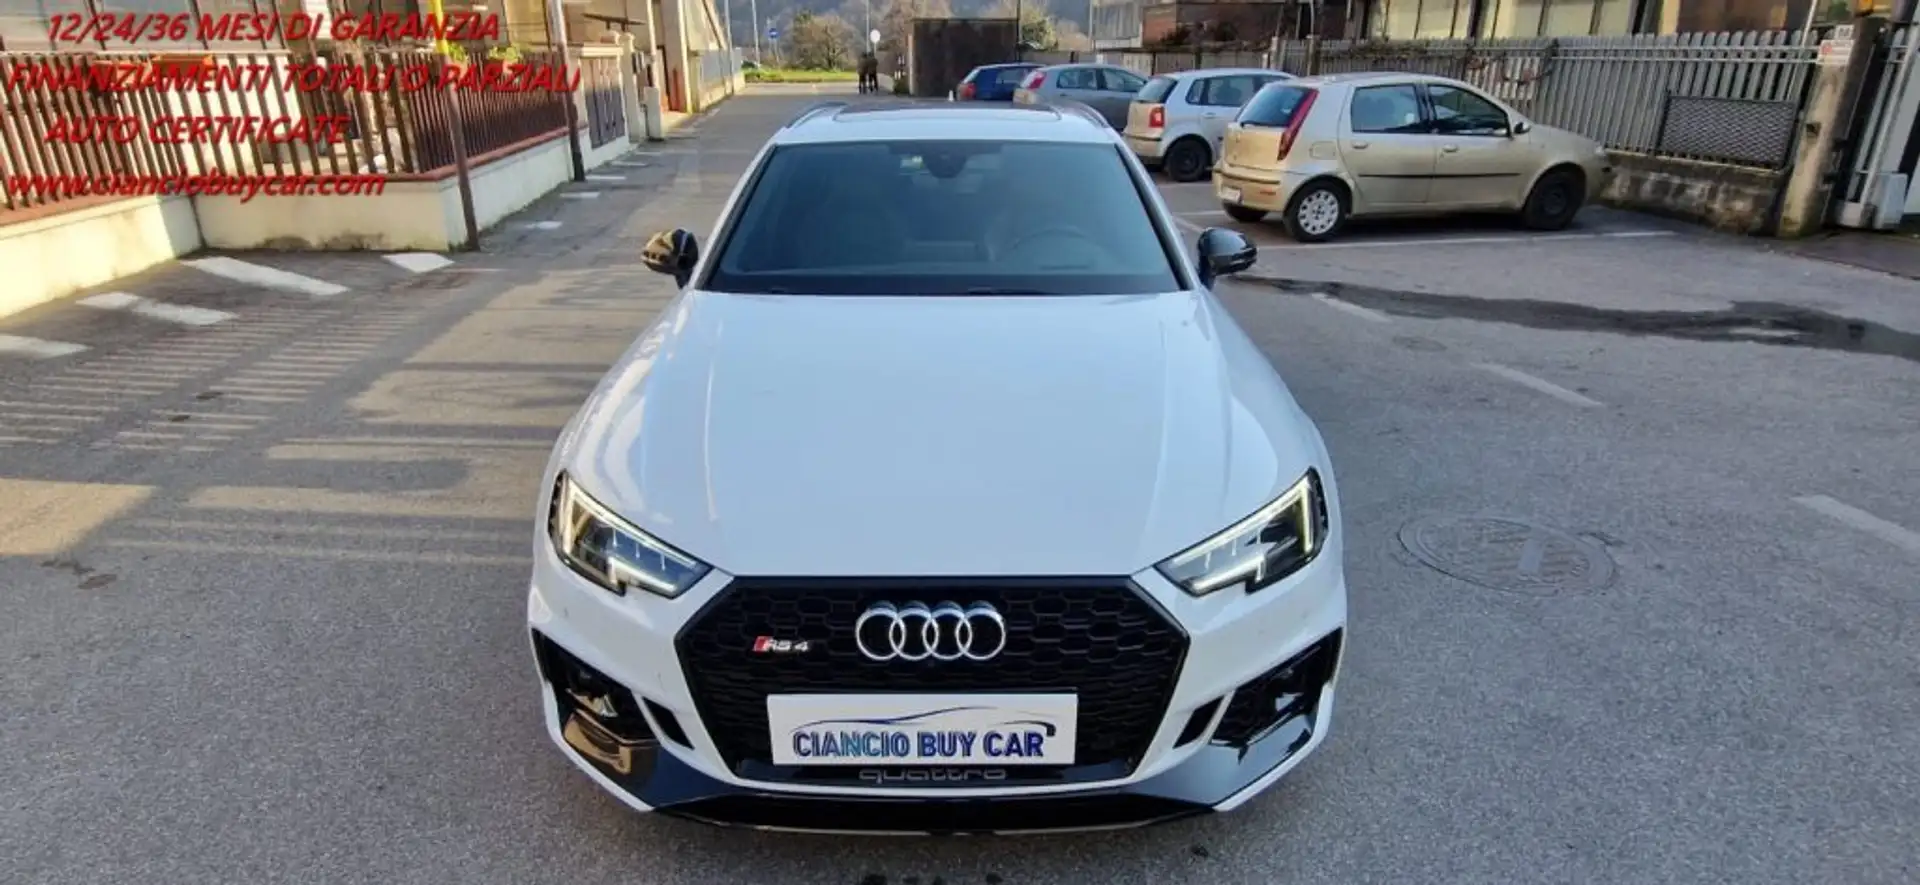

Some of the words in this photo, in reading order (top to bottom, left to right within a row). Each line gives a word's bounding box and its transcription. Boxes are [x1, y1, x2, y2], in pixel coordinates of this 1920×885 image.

[792, 731, 910, 758] CIANCIO
[917, 731, 976, 758] BUY
[982, 731, 1044, 758] CAR
[858, 767, 1008, 784] quattro
